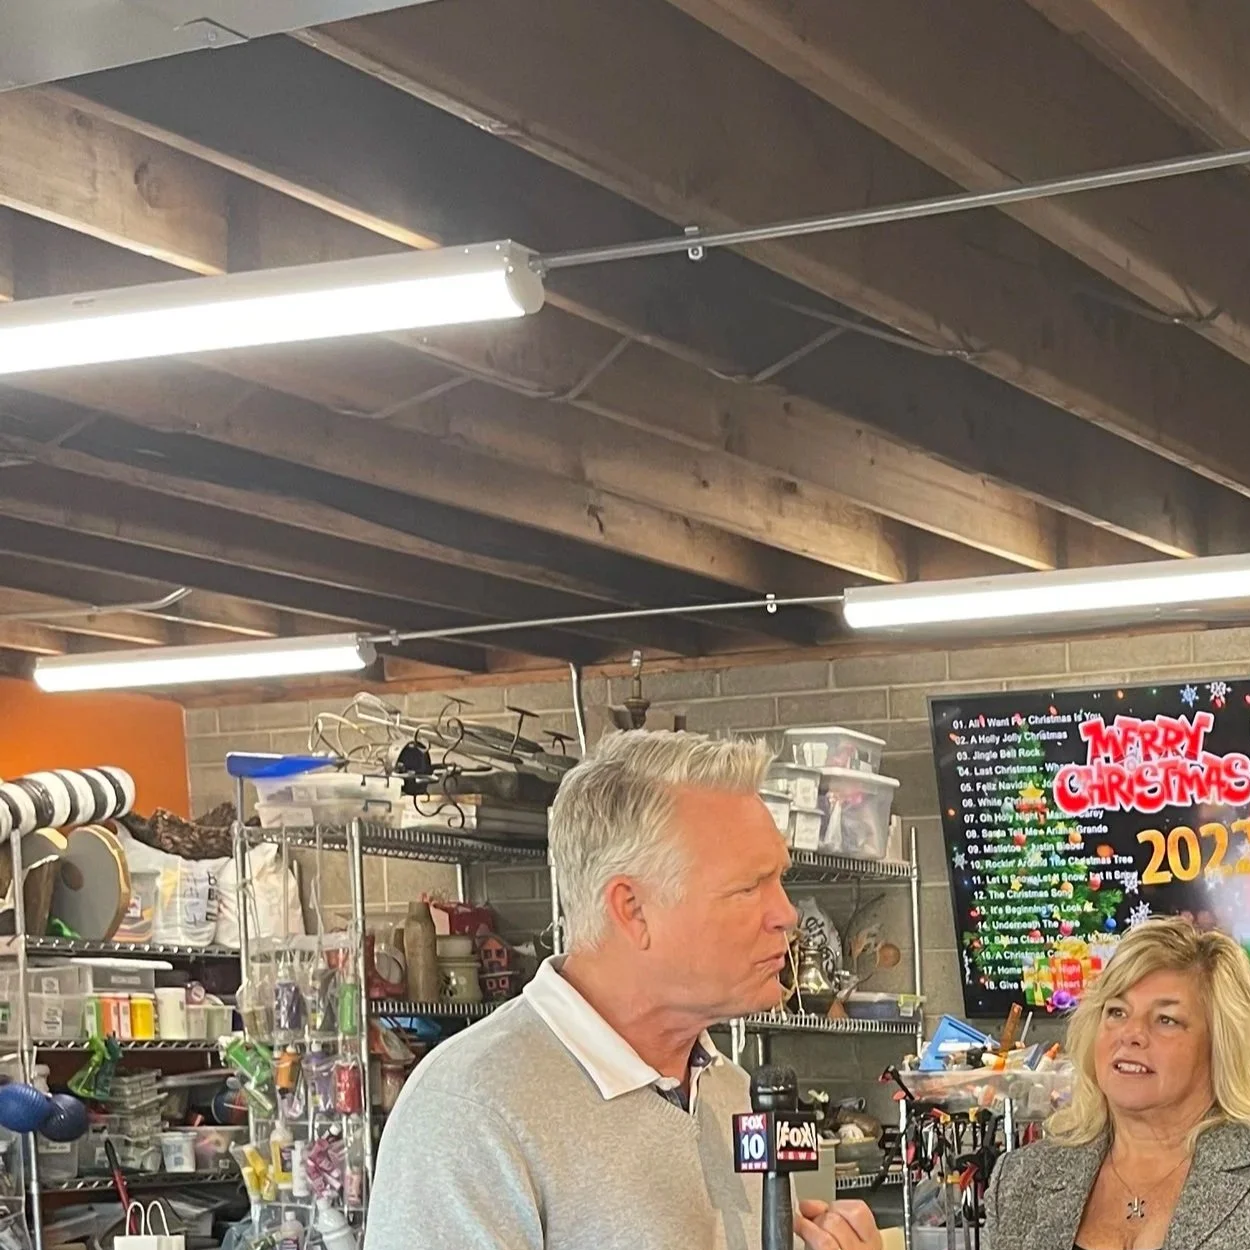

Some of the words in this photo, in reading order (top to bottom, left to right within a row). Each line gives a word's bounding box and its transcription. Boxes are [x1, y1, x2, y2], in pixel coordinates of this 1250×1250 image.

[953, 720, 967, 730] 01.
[987, 717, 1010, 727] Want
[1012, 716, 1026, 726] For
[1028, 714, 1072, 725] Christmas
[1084, 711, 1101, 721] You
[970, 735, 978, 745] A
[978, 734, 1000, 746] Holly
[1002, 733, 1022, 743] Jolly
[1024, 730, 1068, 741] Christmas
[1082, 713, 1212, 763] MERRY
[973, 750, 998, 761] Jingle
[1000, 749, 1017, 759] Bell
[1018, 748, 1041, 758] Rock
[974, 766, 993, 776] Last
[995, 764, 1038, 775] Christmas
[976, 782, 997, 792] Feliz
[978, 797, 1002, 807] White
[963, 814, 978, 824] 07.
[980, 813, 993, 823] Oh
[994, 812, 1014, 824] Holy
[981, 829, 1006, 839] Santa
[1076, 824, 1108, 835] Grande
[983, 843, 1021, 853] Mistletoe
[1030, 841, 1054, 852] Justin
[1056, 840, 1085, 851] Bieber
[1050, 856, 1066, 866] The
[1068, 855, 1111, 866] Christmas
[1113, 854, 1134, 864] Tree
[986, 874, 1000, 884] Let
[989, 890, 1005, 899] The
[1007, 889, 1049, 899] Christmas
[1051, 888, 1073, 899] Song
[990, 905, 1003, 914] It's
[1005, 904, 1046, 915] Beginning
[1061, 903, 1082, 912] Look
[992, 920, 1041, 930] Underneath
[1042, 919, 1059, 928] The
[1061, 919, 1080, 928] Tree
[995, 951, 1003, 960] A
[1004, 949, 1046, 959] Christmas
[998, 965, 1022, 975] Home
[999, 980, 1019, 990] Give
[741, 1114, 764, 1132] FOX
[778, 1122, 815, 1149] FOX
[741, 1133, 766, 1160] 10
[777, 1151, 817, 1160] NEWS
[741, 1161, 768, 1171] NEWS
